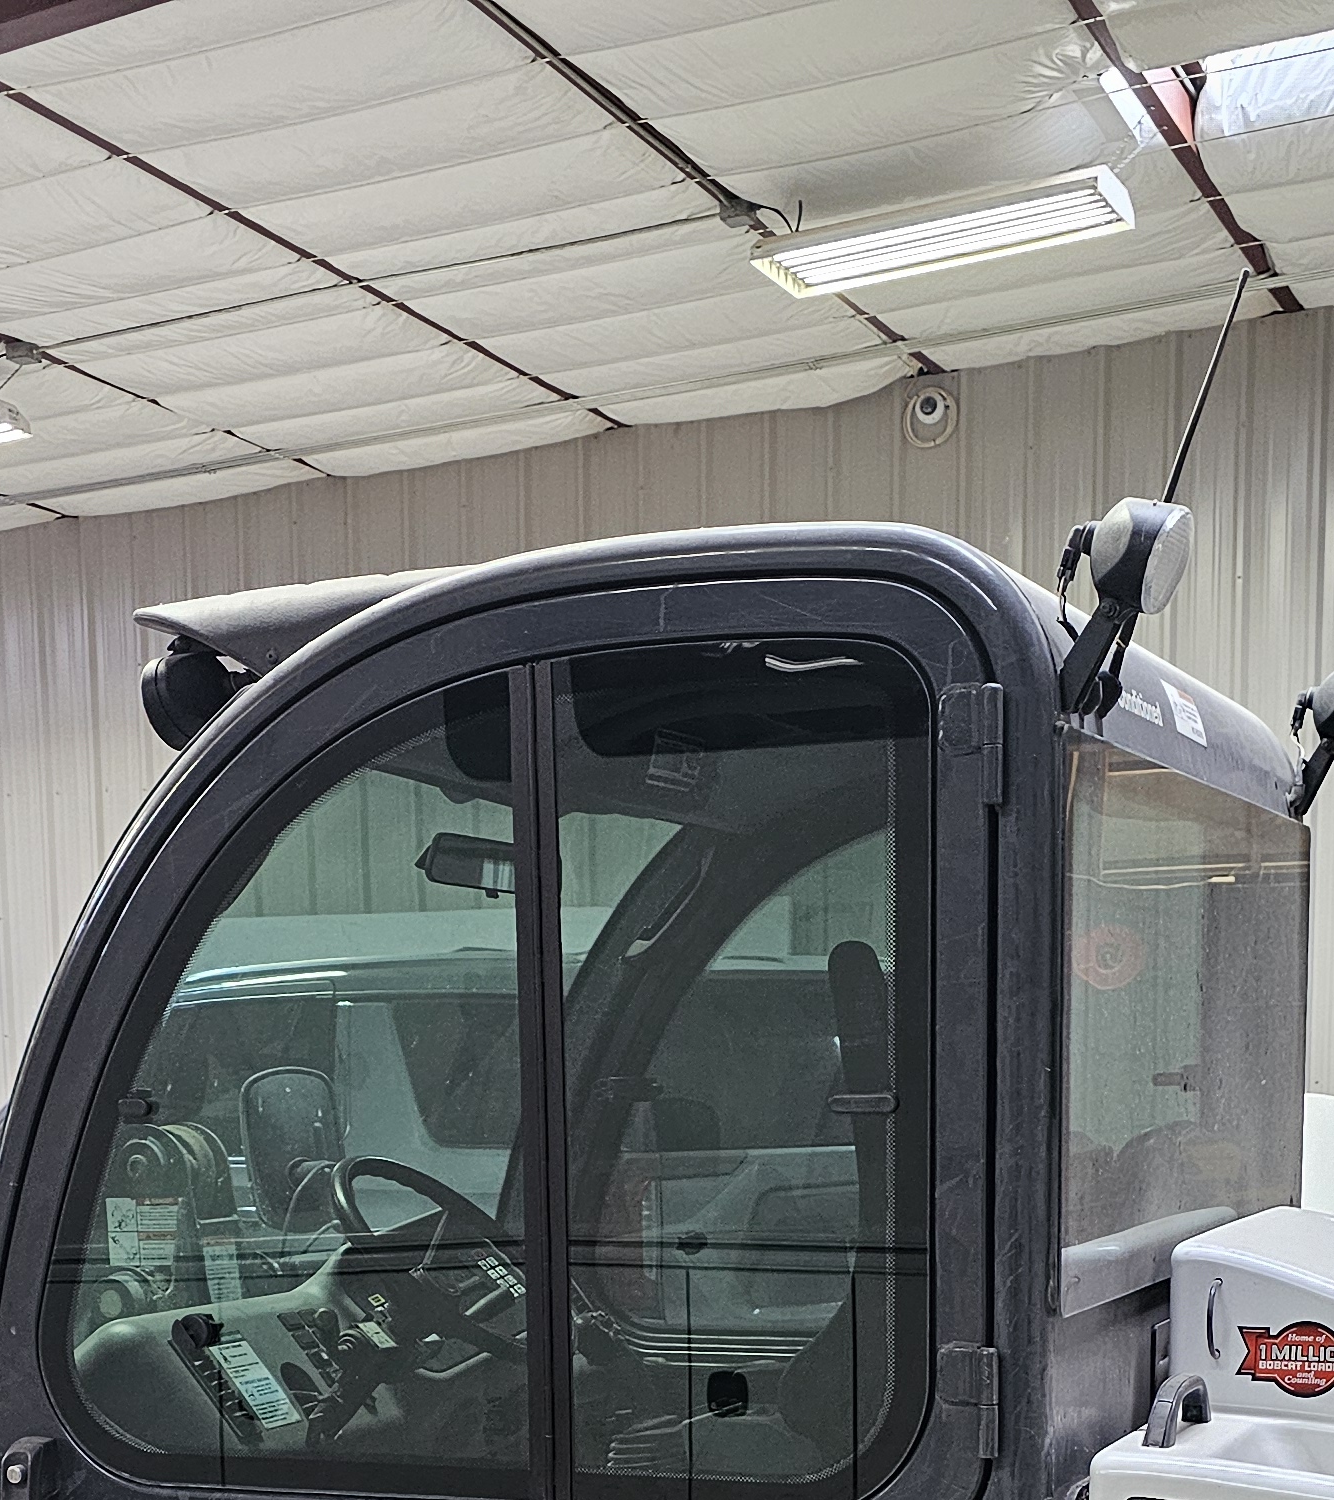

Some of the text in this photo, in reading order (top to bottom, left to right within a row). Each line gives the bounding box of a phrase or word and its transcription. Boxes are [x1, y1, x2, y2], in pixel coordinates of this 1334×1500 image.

[1287, 1333, 1327, 1343] Home of
[1259, 1345, 1266, 1360] 1
[1258, 1360, 1303, 1371] BOBCAT
[1285, 1375, 1327, 1386] Counting
